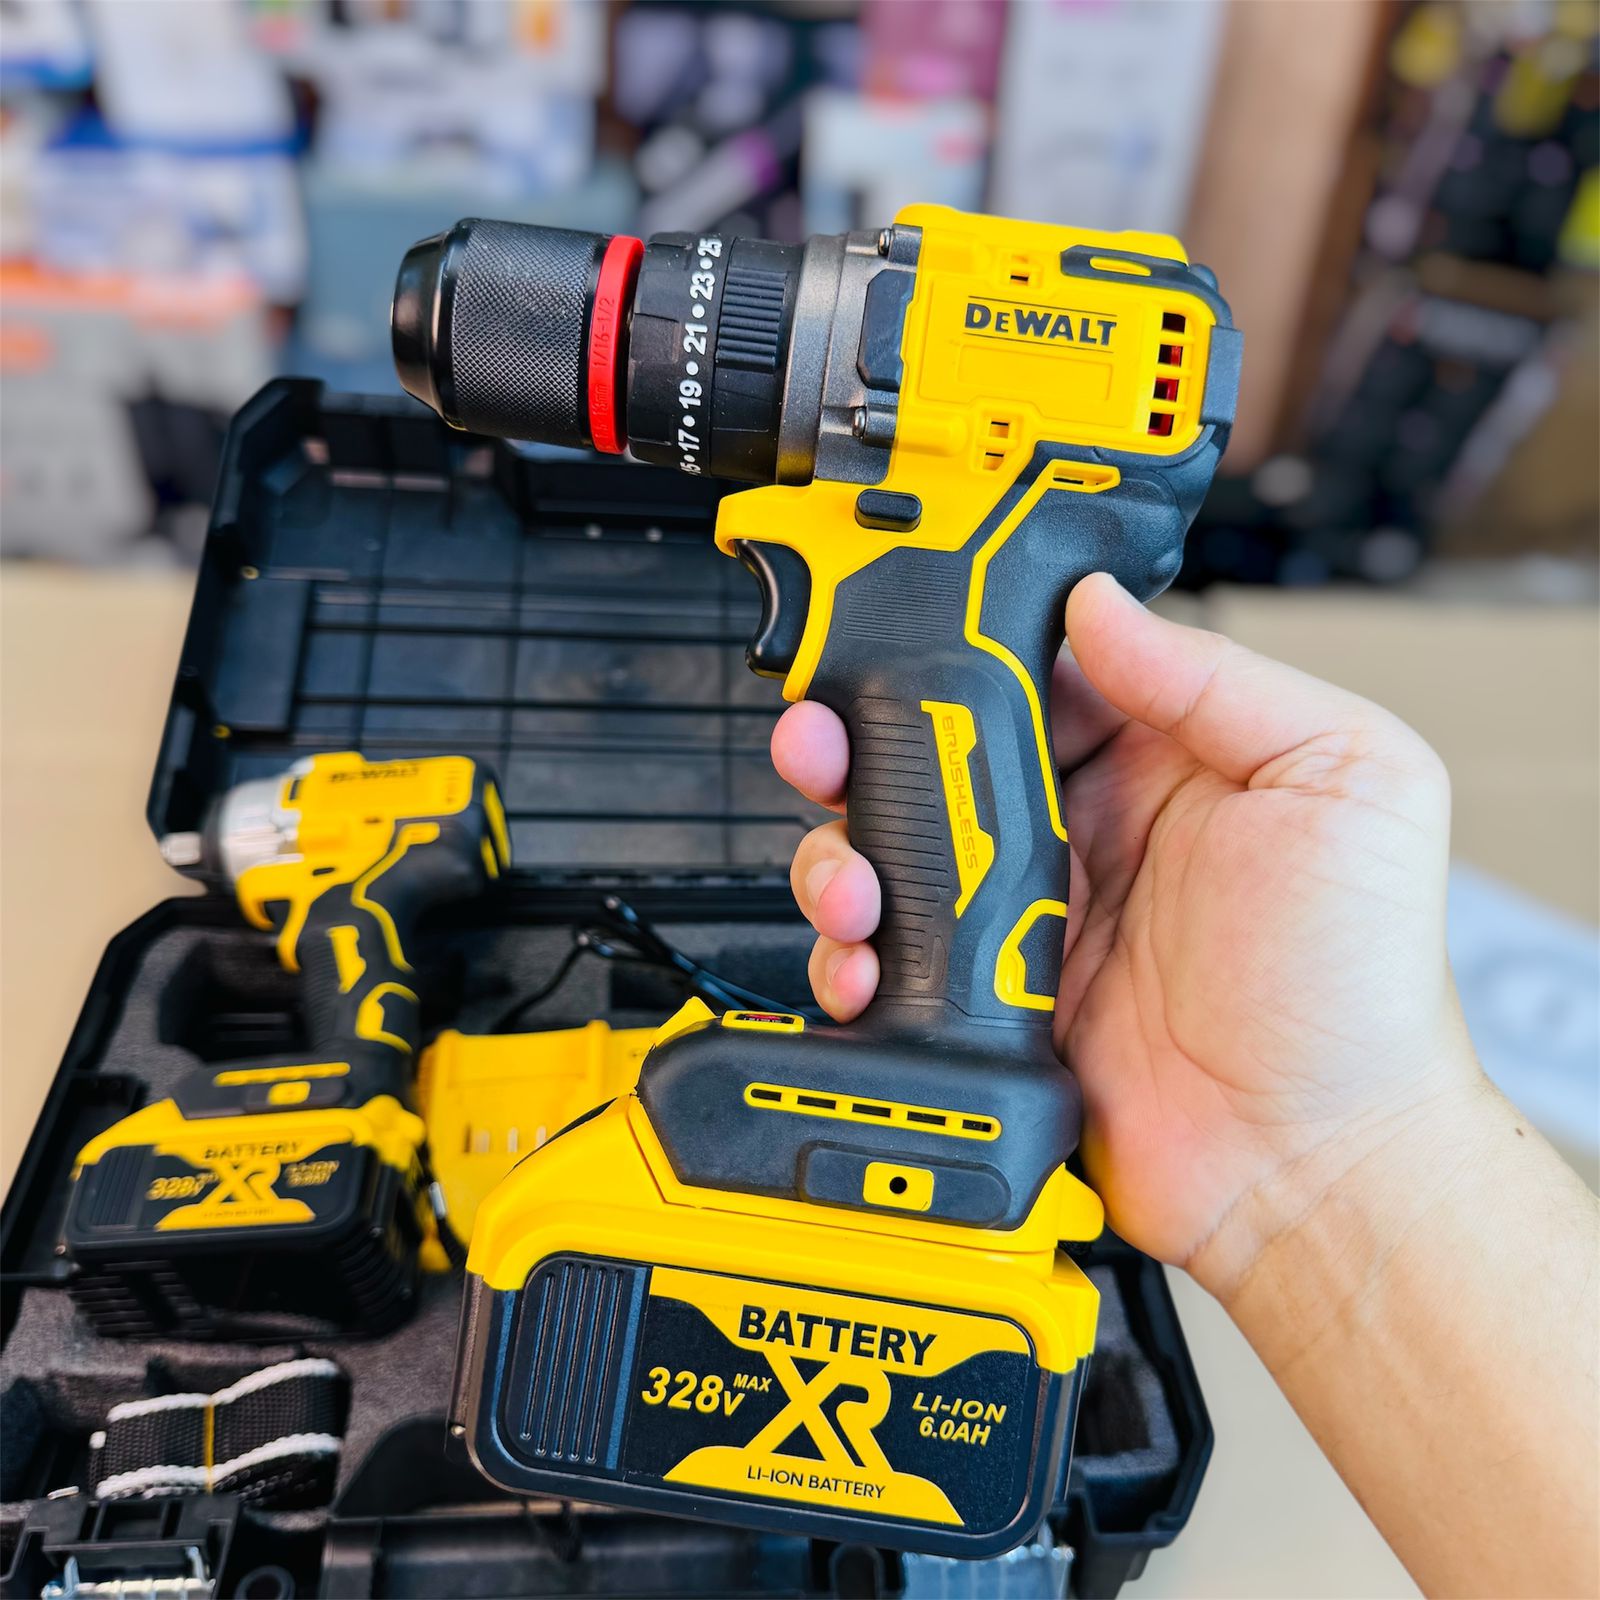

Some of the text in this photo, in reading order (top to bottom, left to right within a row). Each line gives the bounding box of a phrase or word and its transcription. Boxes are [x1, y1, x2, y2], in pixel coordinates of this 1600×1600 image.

[697, 238, 723, 258] 25
[689, 271, 716, 301] 23
[594, 297, 616, 369] 1/16-1/2
[682, 322, 708, 356] 21
[678, 379, 703, 409] 19
[678, 428, 700, 452] 17
[942, 715, 979, 870] BRUSHLESS
[738, 1304, 937, 1367] BATTERY
[733, 1373, 772, 1393] MAX
[744, 1352, 896, 1472] XR
[912, 1392, 1007, 1424] LI-ION
[919, 1416, 991, 1446] 6.0AH
[747, 1466, 886, 1499] LI-ION BATTERY
